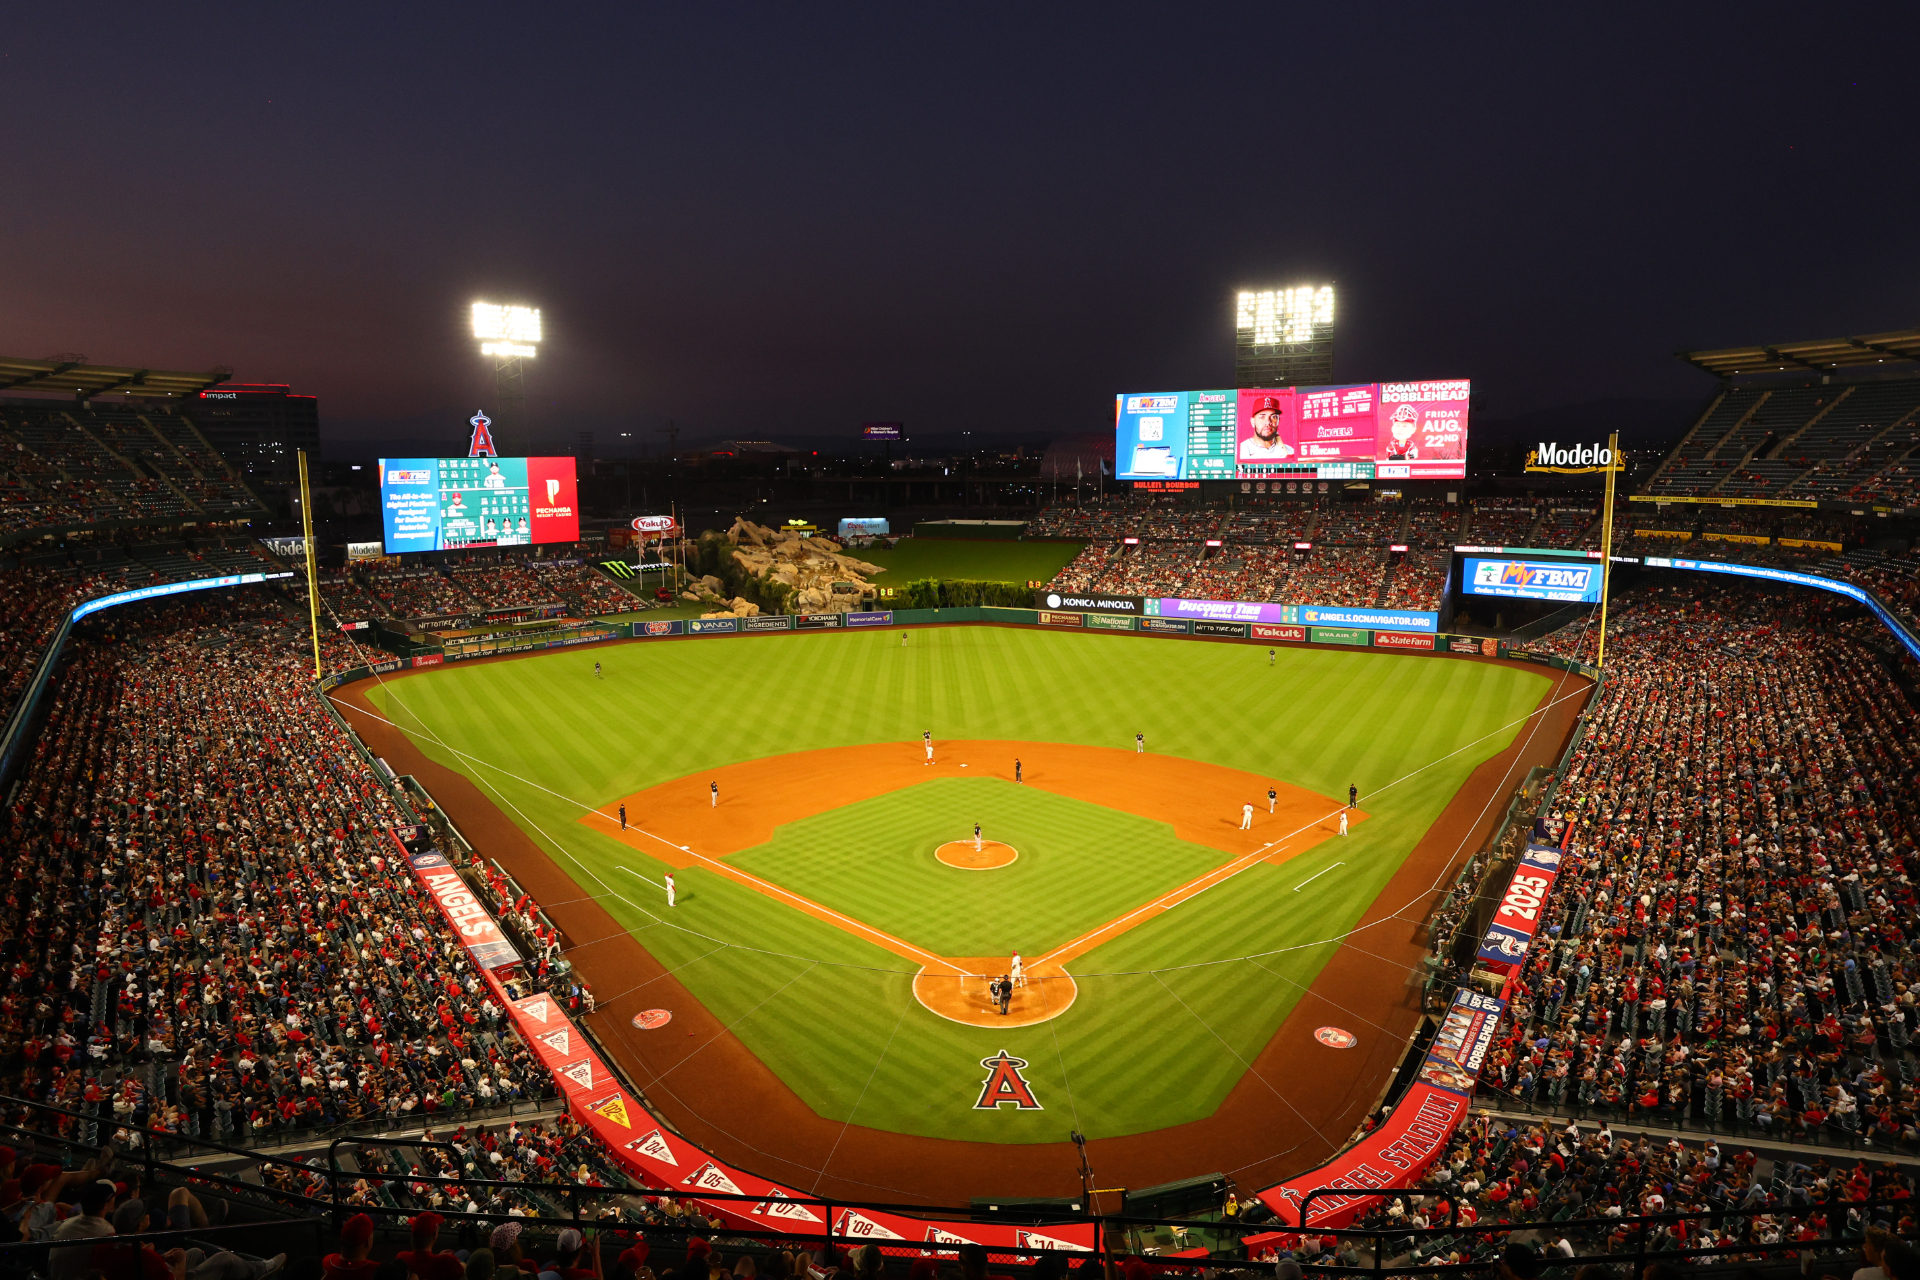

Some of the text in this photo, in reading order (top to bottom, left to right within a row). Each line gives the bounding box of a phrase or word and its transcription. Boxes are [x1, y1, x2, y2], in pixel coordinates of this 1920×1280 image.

[1382, 382, 1469, 393] LOGAN O'HOPPE
[206, 392, 237, 400] impact
[1382, 390, 1468, 403] BOBBLEHEAD
[1425, 410, 1460, 418] FRIDAY
[1422, 419, 1462, 433] AUG.
[1425, 434, 1459, 447] 22ND
[1301, 444, 1307, 455] 5
[1537, 442, 1612, 465] Modelo
[1501, 560, 1588, 589] MyFBM
[1063, 597, 1135, 610] KONICA MINOLTA
[1178, 600, 1262, 615] DISCOUNT TIRE
[700, 621, 734, 629] VANDA
[746, 621, 787, 629] INGREDIENTS
[1100, 616, 1131, 626] National
[1319, 612, 1430, 627] ANGELS.OCNAVIGATOR.ORG
[1255, 627, 1302, 638] Yakult
[425, 873, 495, 937] ANGELS
[1500, 875, 1549, 921] 2025
[1467, 1014, 1499, 1070] BOBBLEHEAD
[972, 1049, 1044, 1110] A
[603, 1102, 623, 1116] '02
[1379, 1092, 1460, 1170] STADIUM
[645, 1140, 665, 1155] '04
[704, 1172, 725, 1187] '05
[1280, 1162, 1395, 1220] ANGEL
[852, 1220, 874, 1236] '08
[1035, 1240, 1054, 1251] '14
